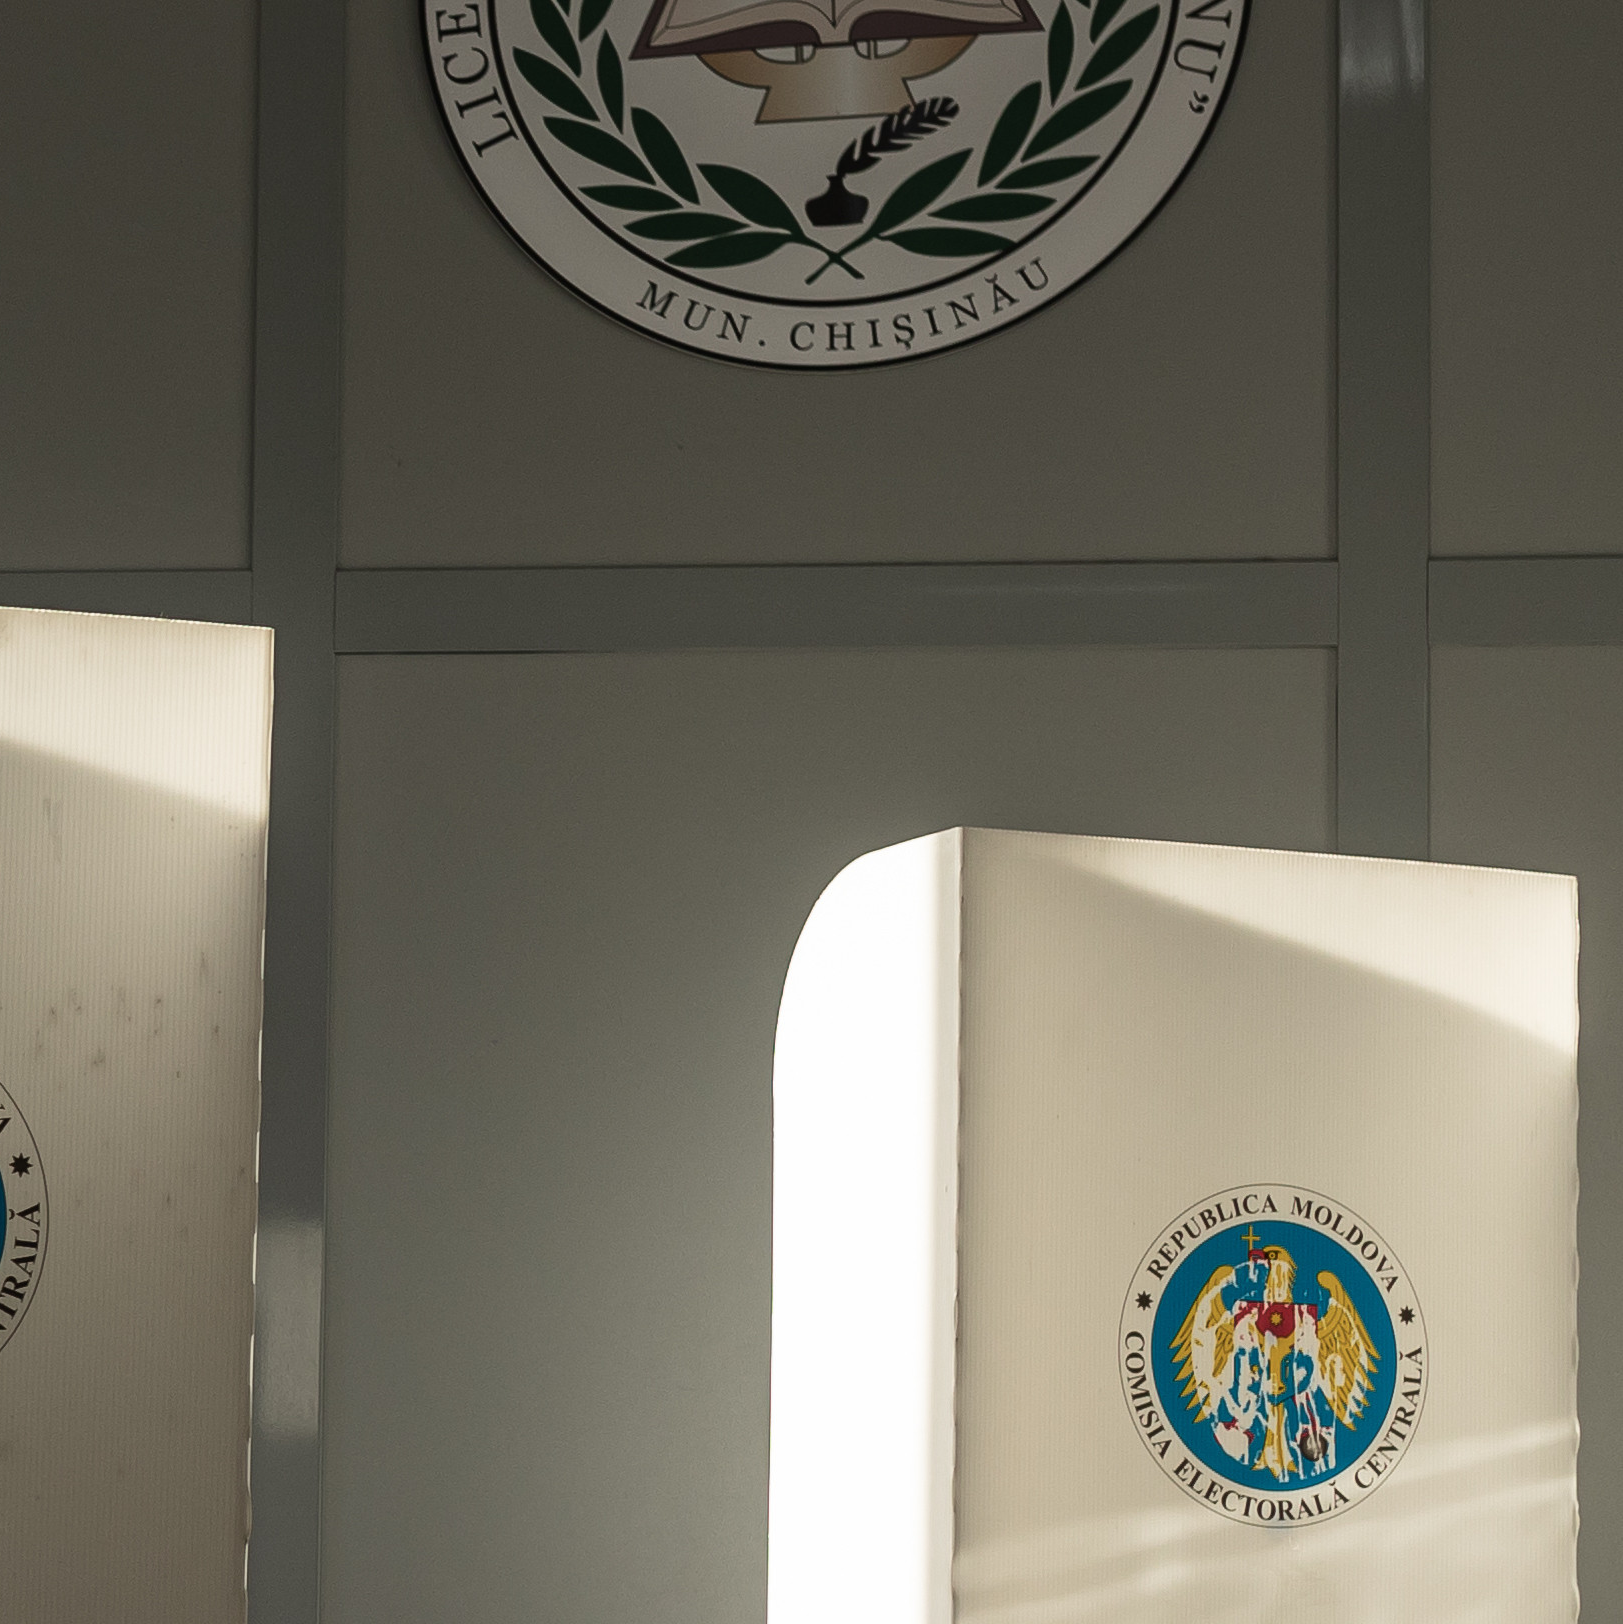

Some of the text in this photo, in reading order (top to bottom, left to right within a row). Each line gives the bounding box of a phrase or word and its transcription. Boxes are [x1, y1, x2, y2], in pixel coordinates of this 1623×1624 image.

[634, 279, 767, 348] MUN.
[1145, 1192, 1400, 1294] REPUBLICA MOLDOVA
[1124, 1330, 1423, 1522] COMISIA ELECTORALĂ CENTRALĂ
